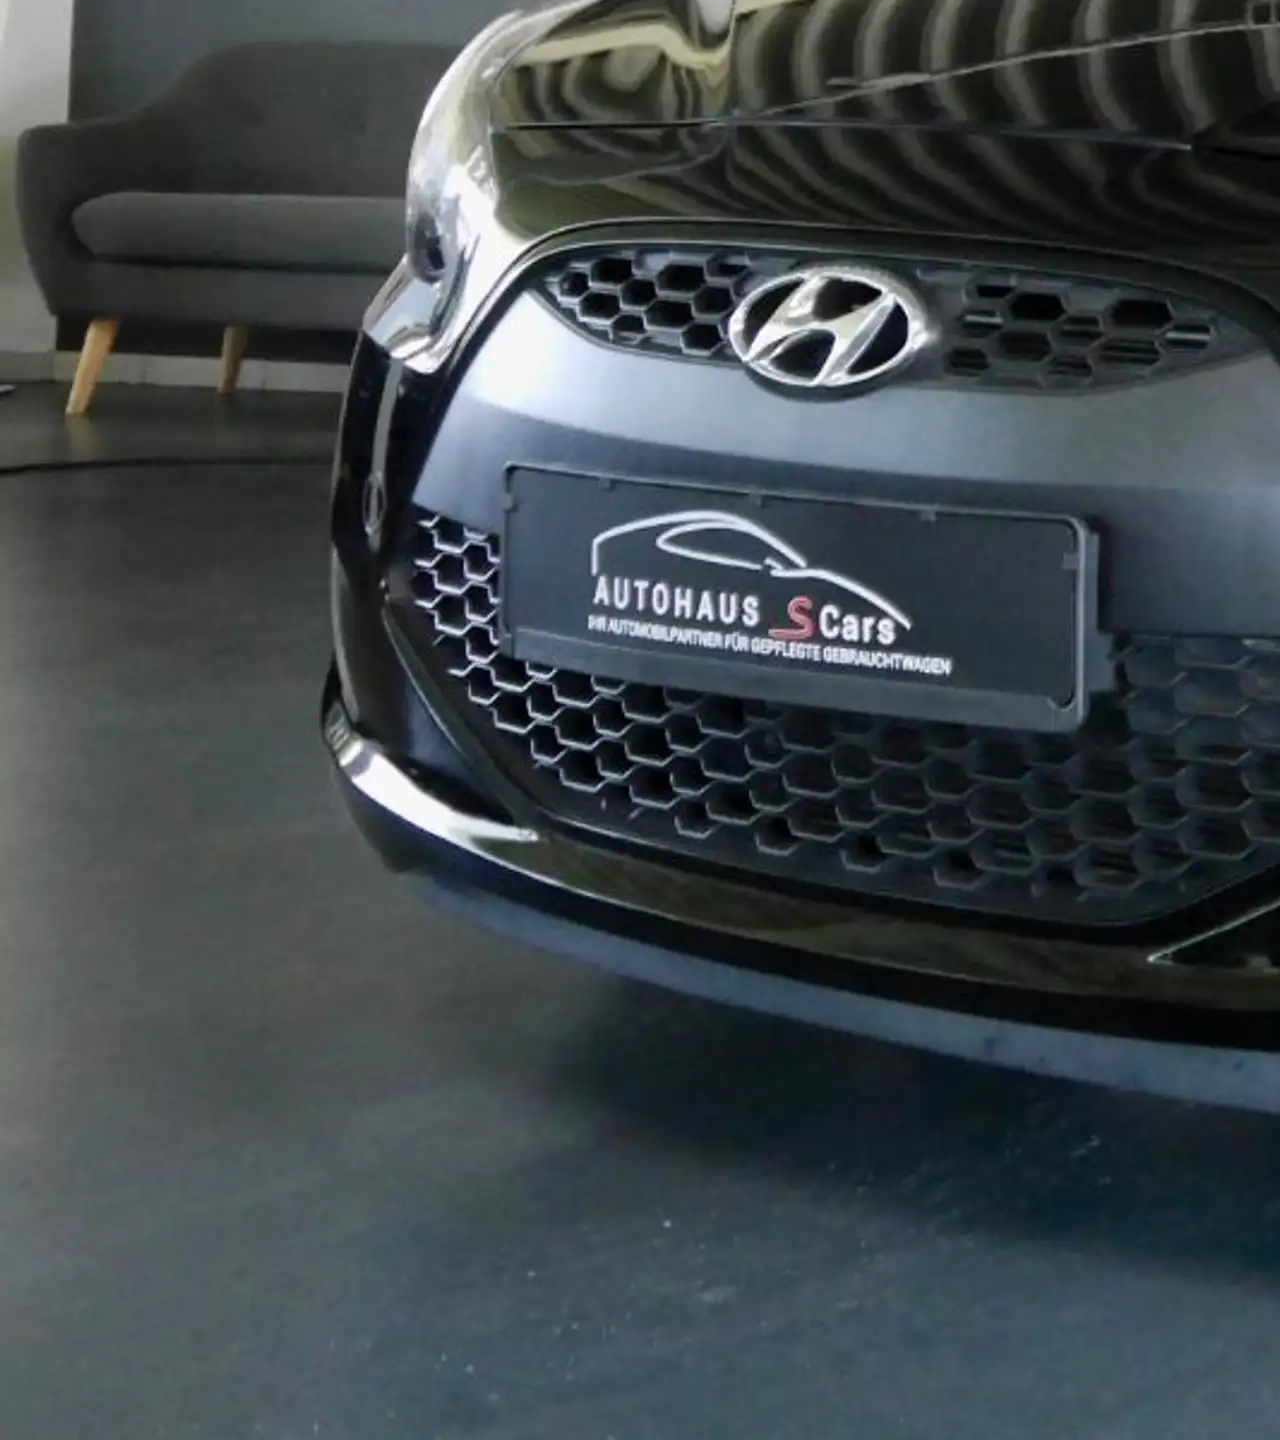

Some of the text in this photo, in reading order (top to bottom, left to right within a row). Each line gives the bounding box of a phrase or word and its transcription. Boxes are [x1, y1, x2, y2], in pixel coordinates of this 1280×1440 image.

[592, 574, 897, 645] AUTOHAUS S Cars
